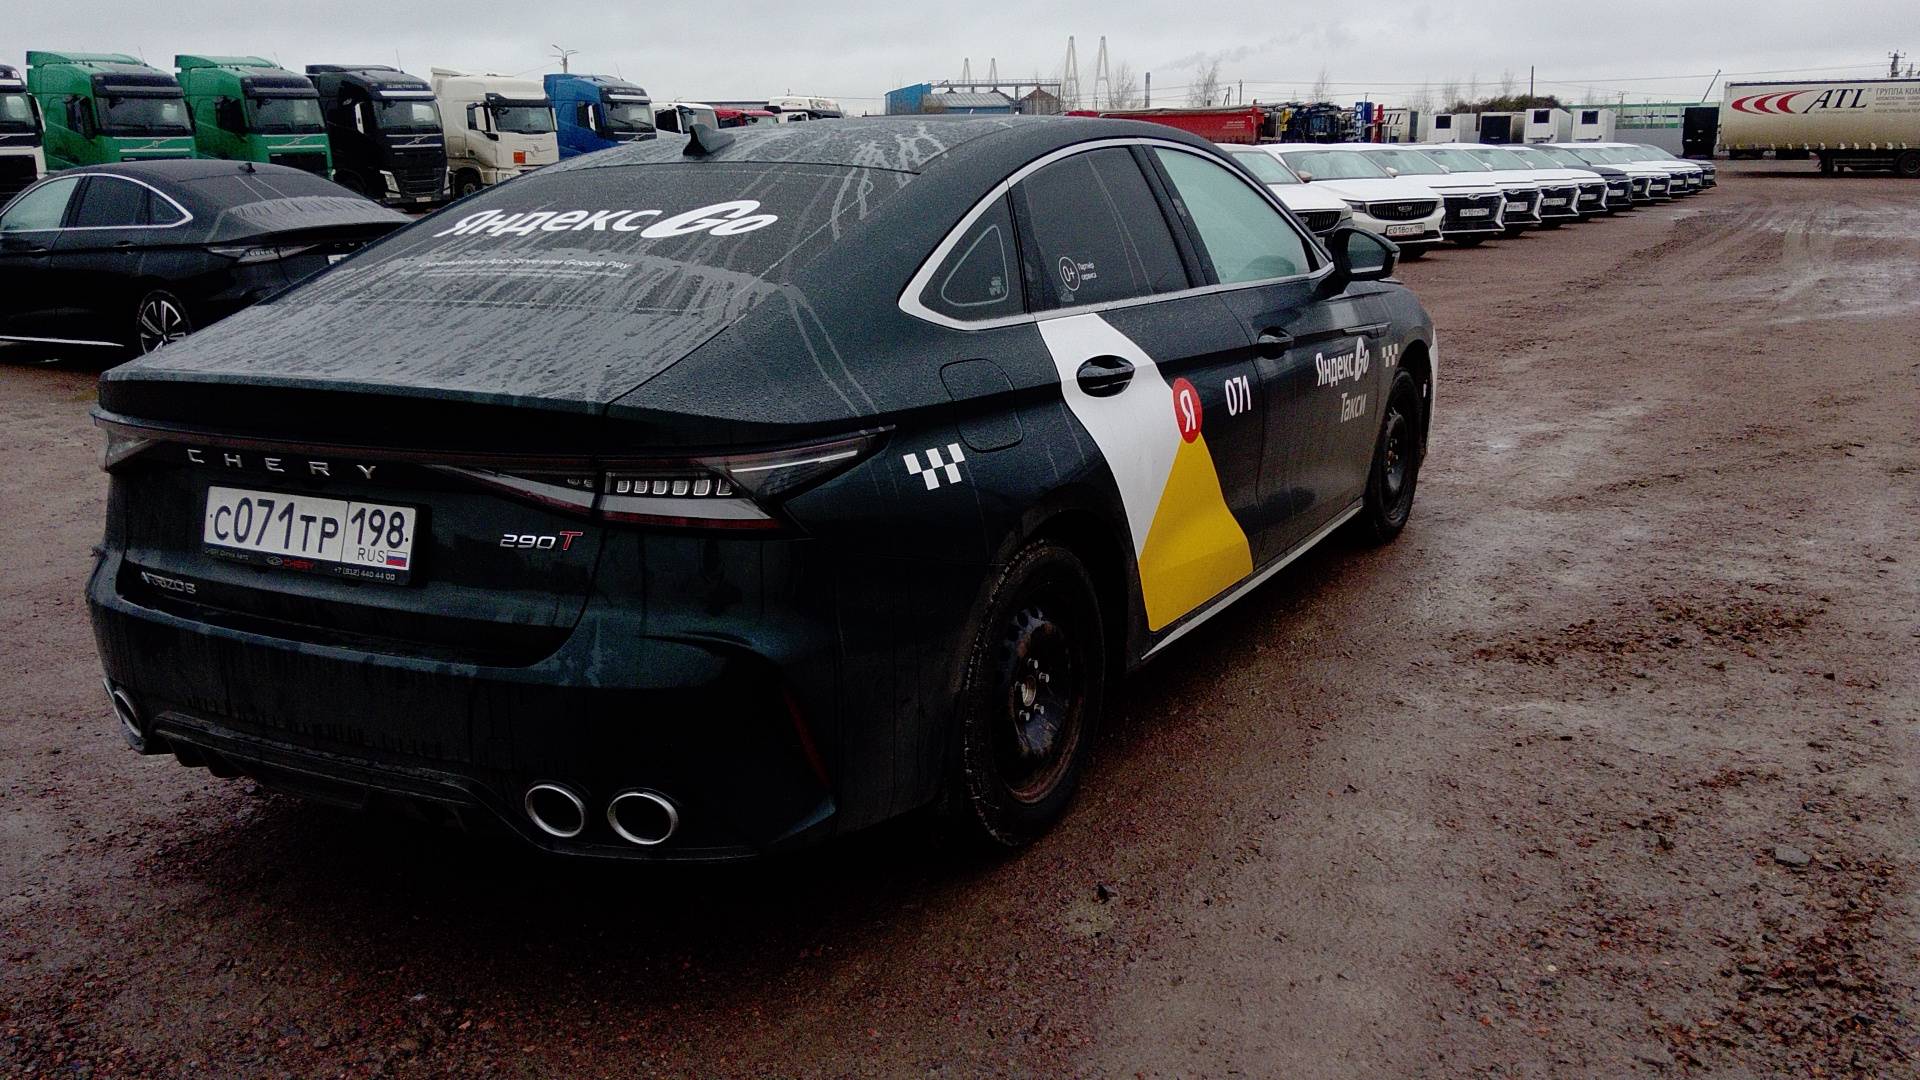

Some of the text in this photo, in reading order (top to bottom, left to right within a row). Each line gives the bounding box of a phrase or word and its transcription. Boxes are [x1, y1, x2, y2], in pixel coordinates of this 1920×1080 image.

[1802, 89, 1867, 113] ATL
[1875, 87, 1904, 96] ГРУППА
[433, 200, 778, 238] Яндекс Go
[1316, 336, 1370, 388] Яндекс Go
[1179, 389, 1197, 433] Я
[1225, 375, 1252, 417] 071
[1340, 392, 1367, 423] Такси
[187, 448, 376, 480] CHERY
[350, 507, 405, 549] 198
[357, 547, 385, 564] RUS
